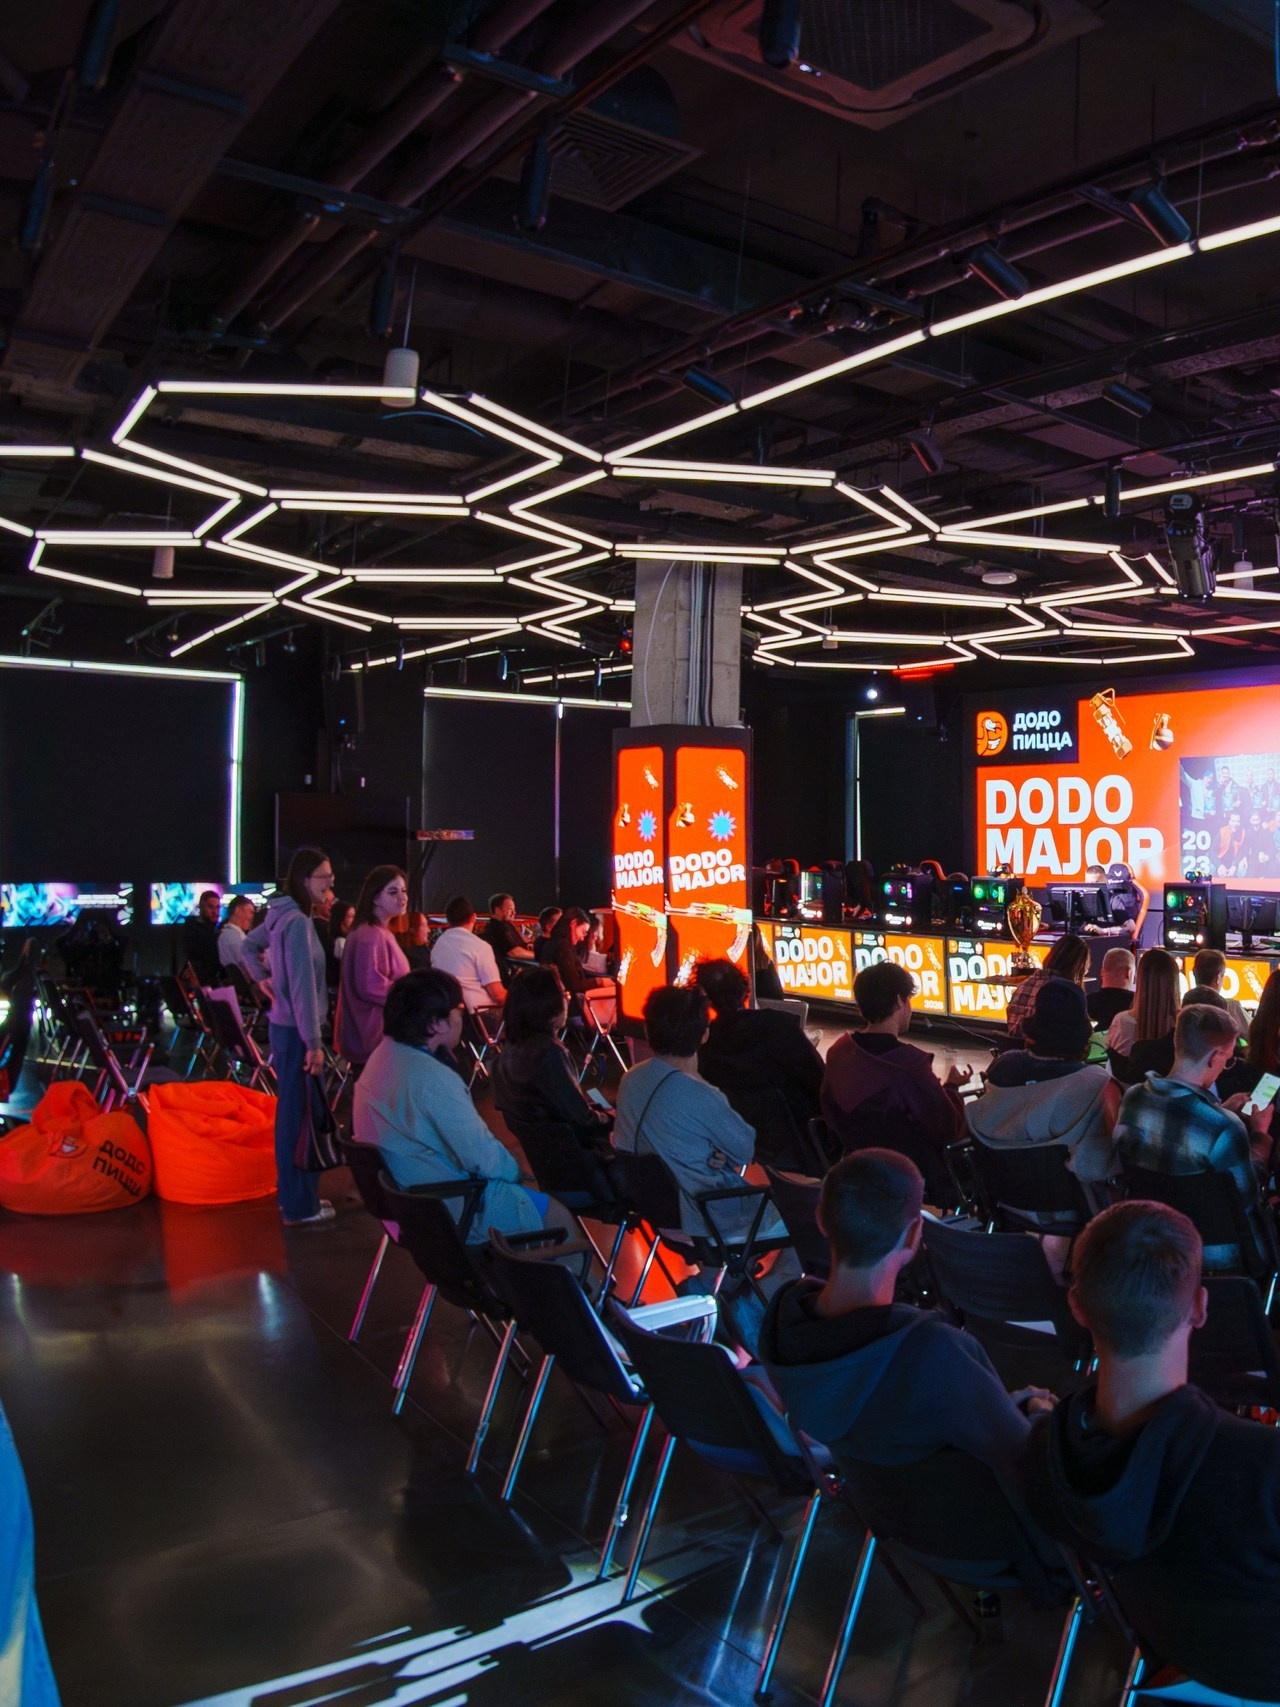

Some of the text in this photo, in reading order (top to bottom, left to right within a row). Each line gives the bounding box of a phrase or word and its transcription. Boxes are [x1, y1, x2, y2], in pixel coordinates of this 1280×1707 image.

[1013, 710, 1062, 732] ДОДО
[1013, 731, 1073, 751] ПИЦЦА
[985, 774, 1134, 826] DODO
[1182, 830, 1212, 850] 20
[614, 849, 654, 872] DODO
[669, 849, 732, 874] DODO
[986, 827, 1165, 879] MAJOR
[1182, 855, 1211, 874] 23
[615, 866, 664, 889] MAJOR
[671, 864, 746, 892] MAJOR
[775, 936, 834, 963] DODO
[777, 961, 848, 988] MAJOR
